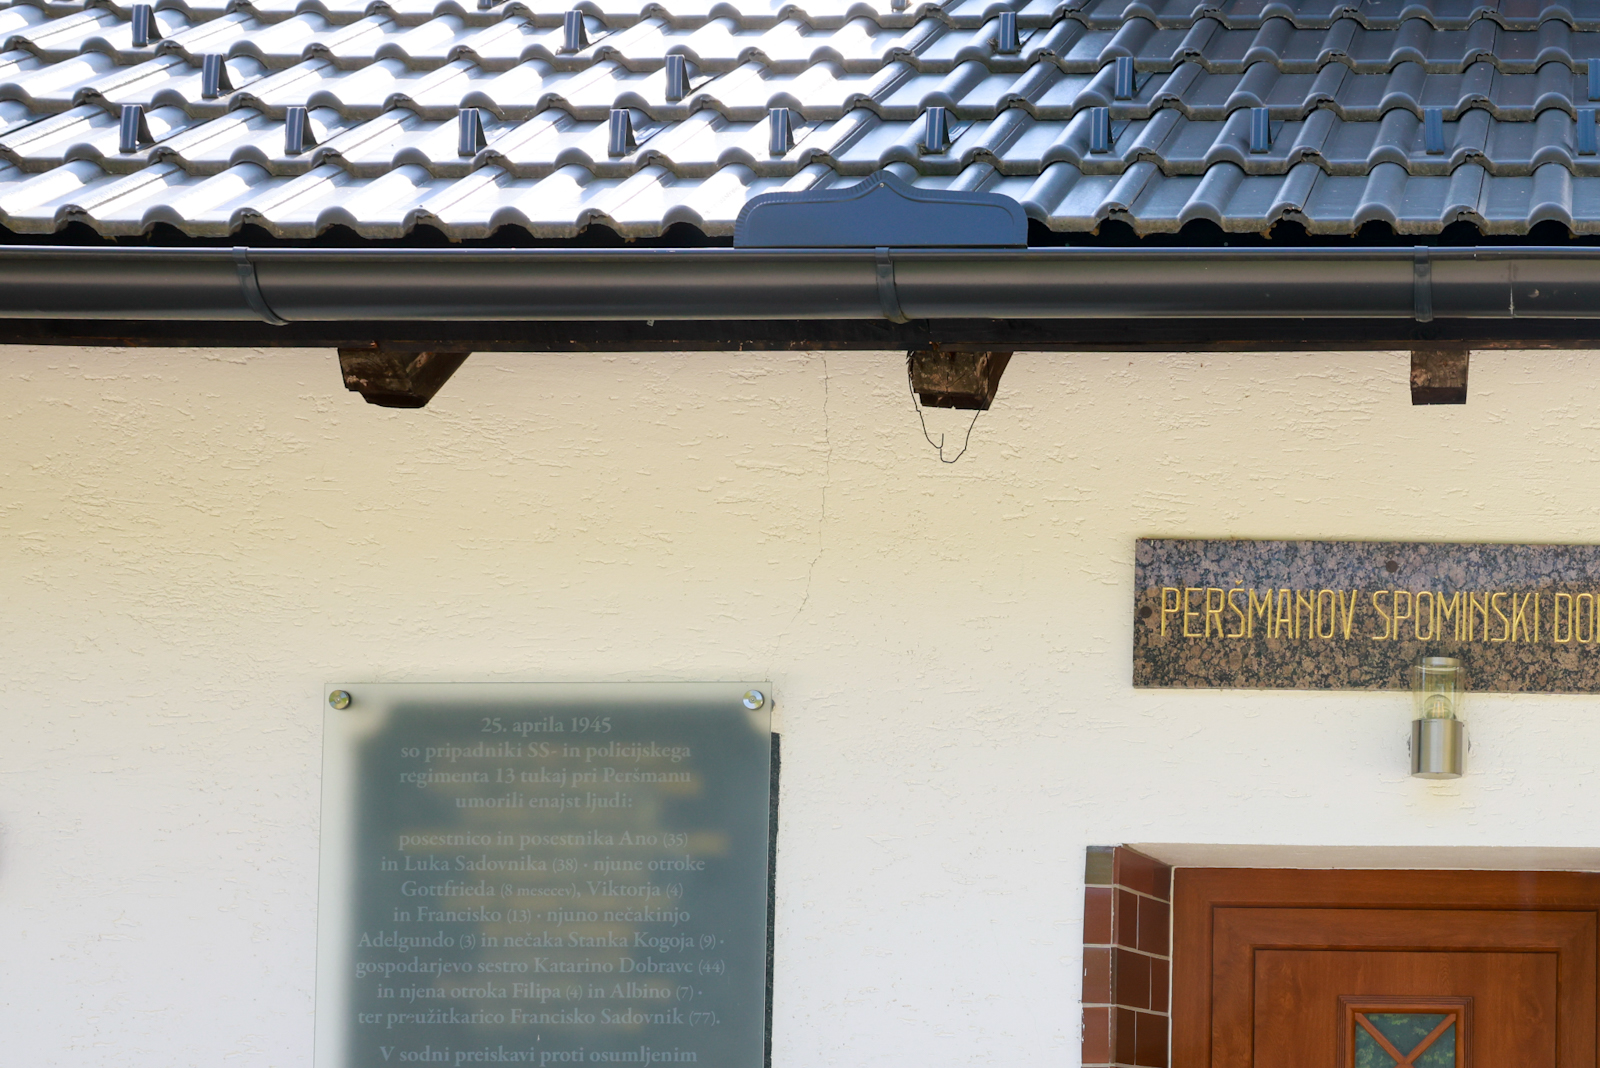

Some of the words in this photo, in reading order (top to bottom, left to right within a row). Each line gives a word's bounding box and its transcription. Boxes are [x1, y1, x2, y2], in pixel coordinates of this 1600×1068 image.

[1160, 580, 1357, 641] PERŠMANOV
[1372, 590, 1541, 643] SPOMINSKI
[482, 716, 507, 733] 25.
[513, 716, 564, 737] aprila
[572, 716, 611, 733] 1945
[401, 746, 420, 758] so
[425, 741, 522, 762] pripadniki
[527, 741, 558, 758] SS-
[562, 741, 580, 758] in
[586, 741, 691, 762] policijskega
[400, 766, 489, 788] regimenta
[496, 766, 515, 784] 13
[521, 766, 566, 788] tukaj
[572, 766, 597, 788] pri
[602, 766, 692, 784] Peršmanu
[456, 791, 523, 809] umorili
[529, 791, 580, 813] enajst
[586, 791, 633, 813] ljudi:
[399, 829, 493, 850] posestnico
[496, 829, 514, 846] in
[520, 829, 614, 850] posestnika
[618, 829, 658, 846] Ano
[381, 854, 399, 871] in
[405, 854, 450, 871] Luka
[455, 854, 547, 871] Sadovnika
[593, 854, 643, 875] njune
[648, 854, 706, 871] otroke
[401, 879, 495, 897] Gottfrieda
[517, 881, 582, 901] mesecev),
[587, 879, 662, 901] Viktorja
[393, 905, 410, 922] in
[417, 905, 501, 922] Francisko
[547, 905, 598, 926] njuno
[604, 905, 690, 926] nečakinjo
[359, 930, 454, 952] Adelgundo
[481, 930, 498, 948] in
[504, 930, 563, 948] nečaka
[568, 930, 628, 948] Stanka
[634, 930, 694, 952] Kogoja
[355, 956, 473, 977] gospodarjevo
[478, 956, 528, 973] sestro
[534, 956, 614, 973] Katarino
[377, 981, 394, 999] in
[400, 981, 446, 1003] njena
[450, 981, 507, 999] otroka
[512, 981, 561, 1003] Filipa
[588, 981, 605, 999] in
[610, 981, 671, 999] Albino
[359, 1007, 382, 1025] ter
[510, 1007, 595, 1025] Francisko
[601, 1007, 684, 1025] Sadovnik
[379, 1045, 395, 1062] V
[400, 1045, 449, 1062] sodni
[455, 1045, 534, 1066] preiskavi
[540, 1045, 584, 1066] proti
[589, 1045, 697, 1066] osumljenim
